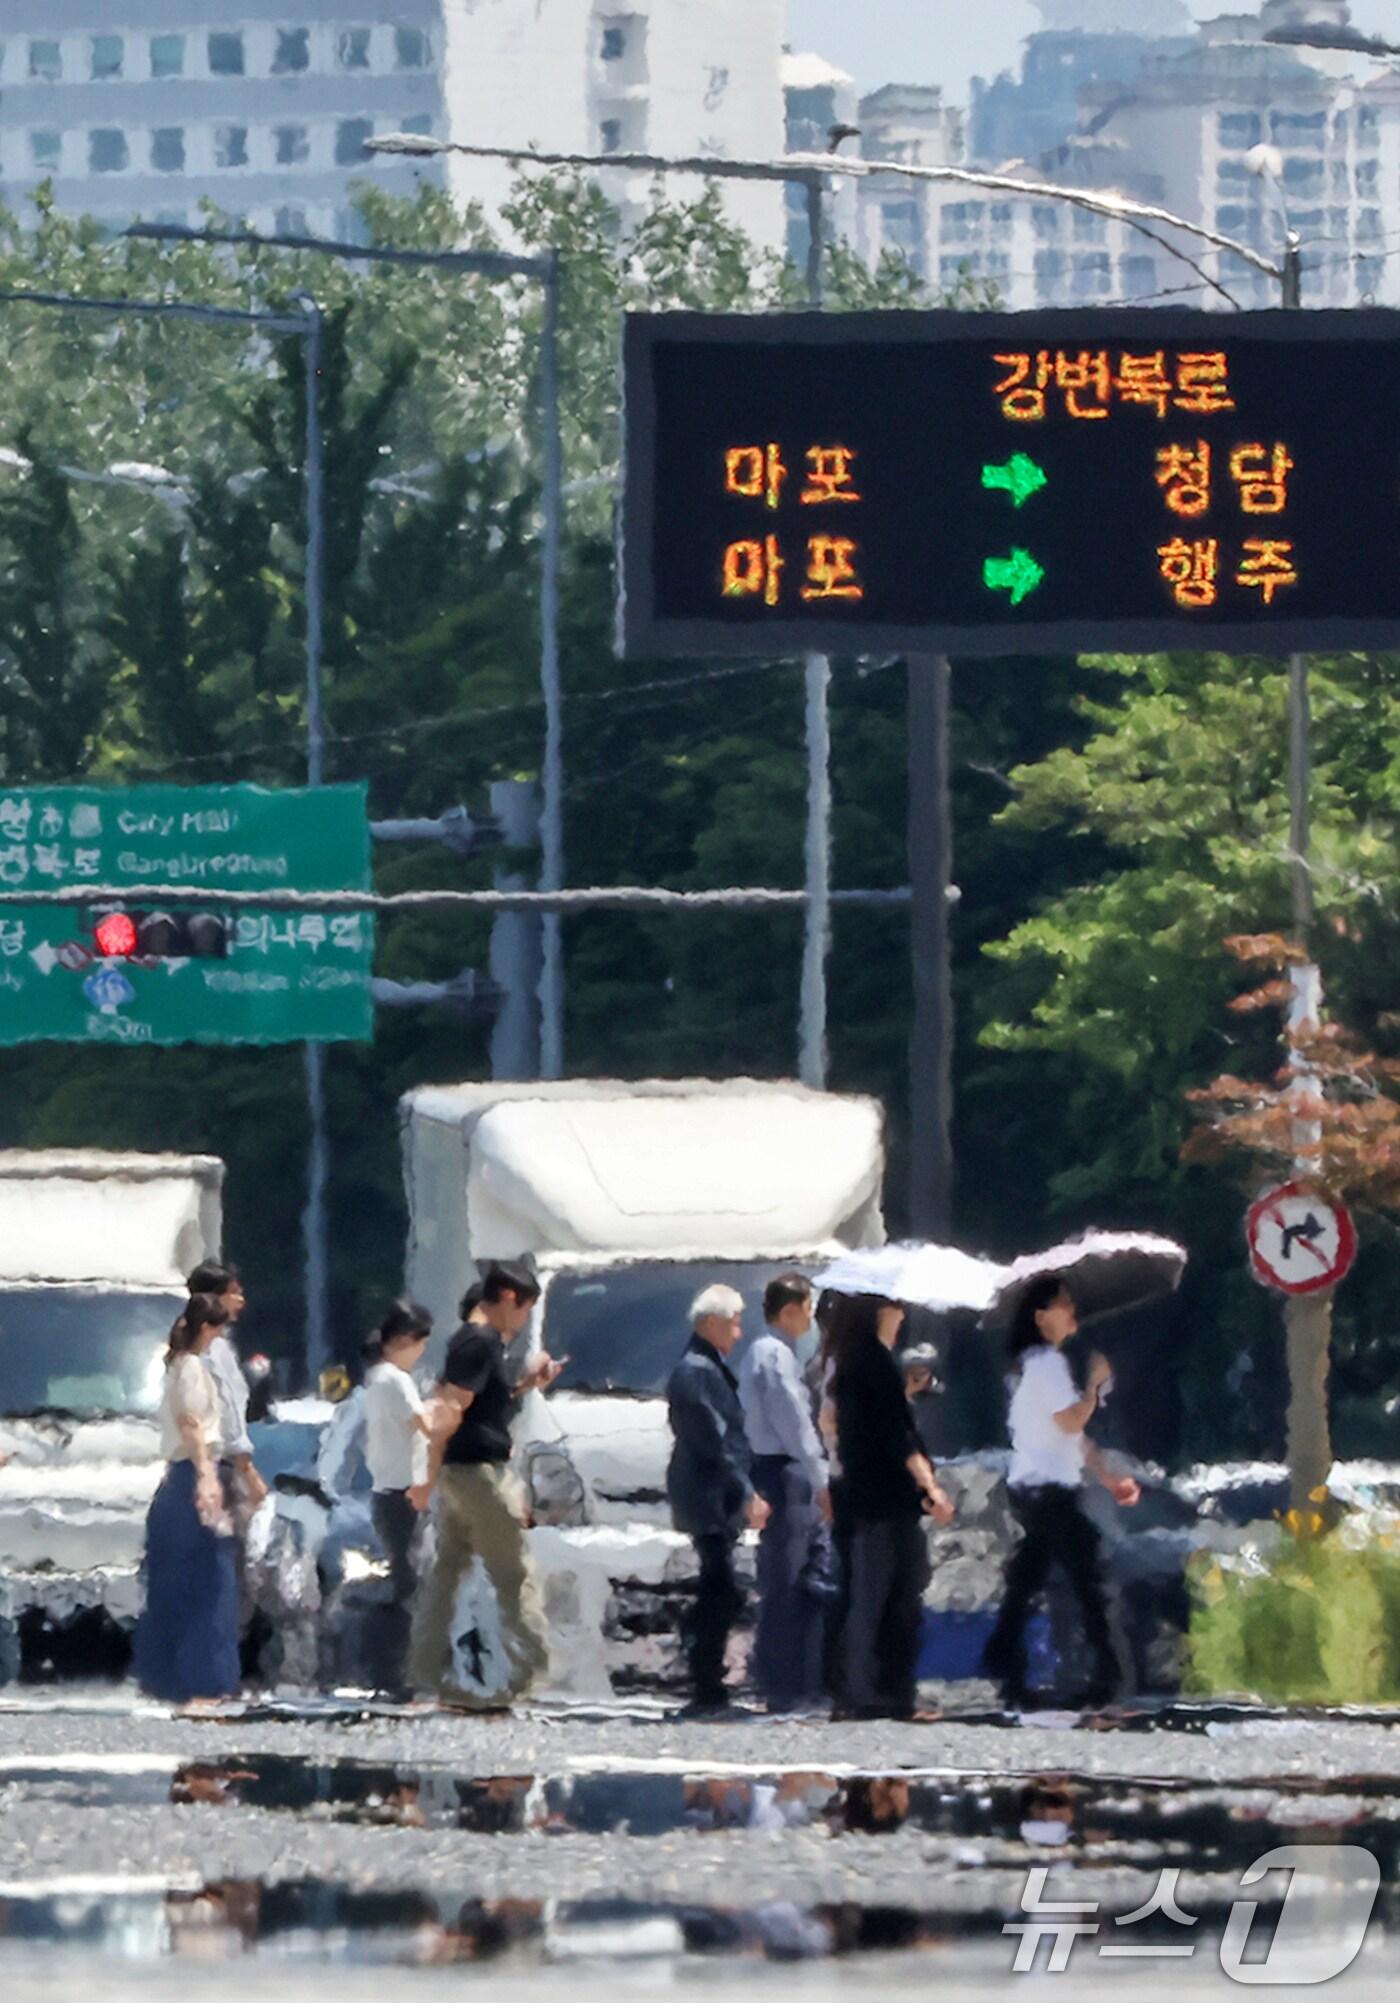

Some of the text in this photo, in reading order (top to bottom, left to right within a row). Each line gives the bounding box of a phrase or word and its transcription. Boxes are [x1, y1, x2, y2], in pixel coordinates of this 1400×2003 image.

[992, 350, 1236, 421] 강변북로
[725, 442, 861, 508] 마포
[1155, 439, 1295, 517] 청담
[722, 533, 863, 606] 마포
[1157, 537, 1298, 607] 행주
